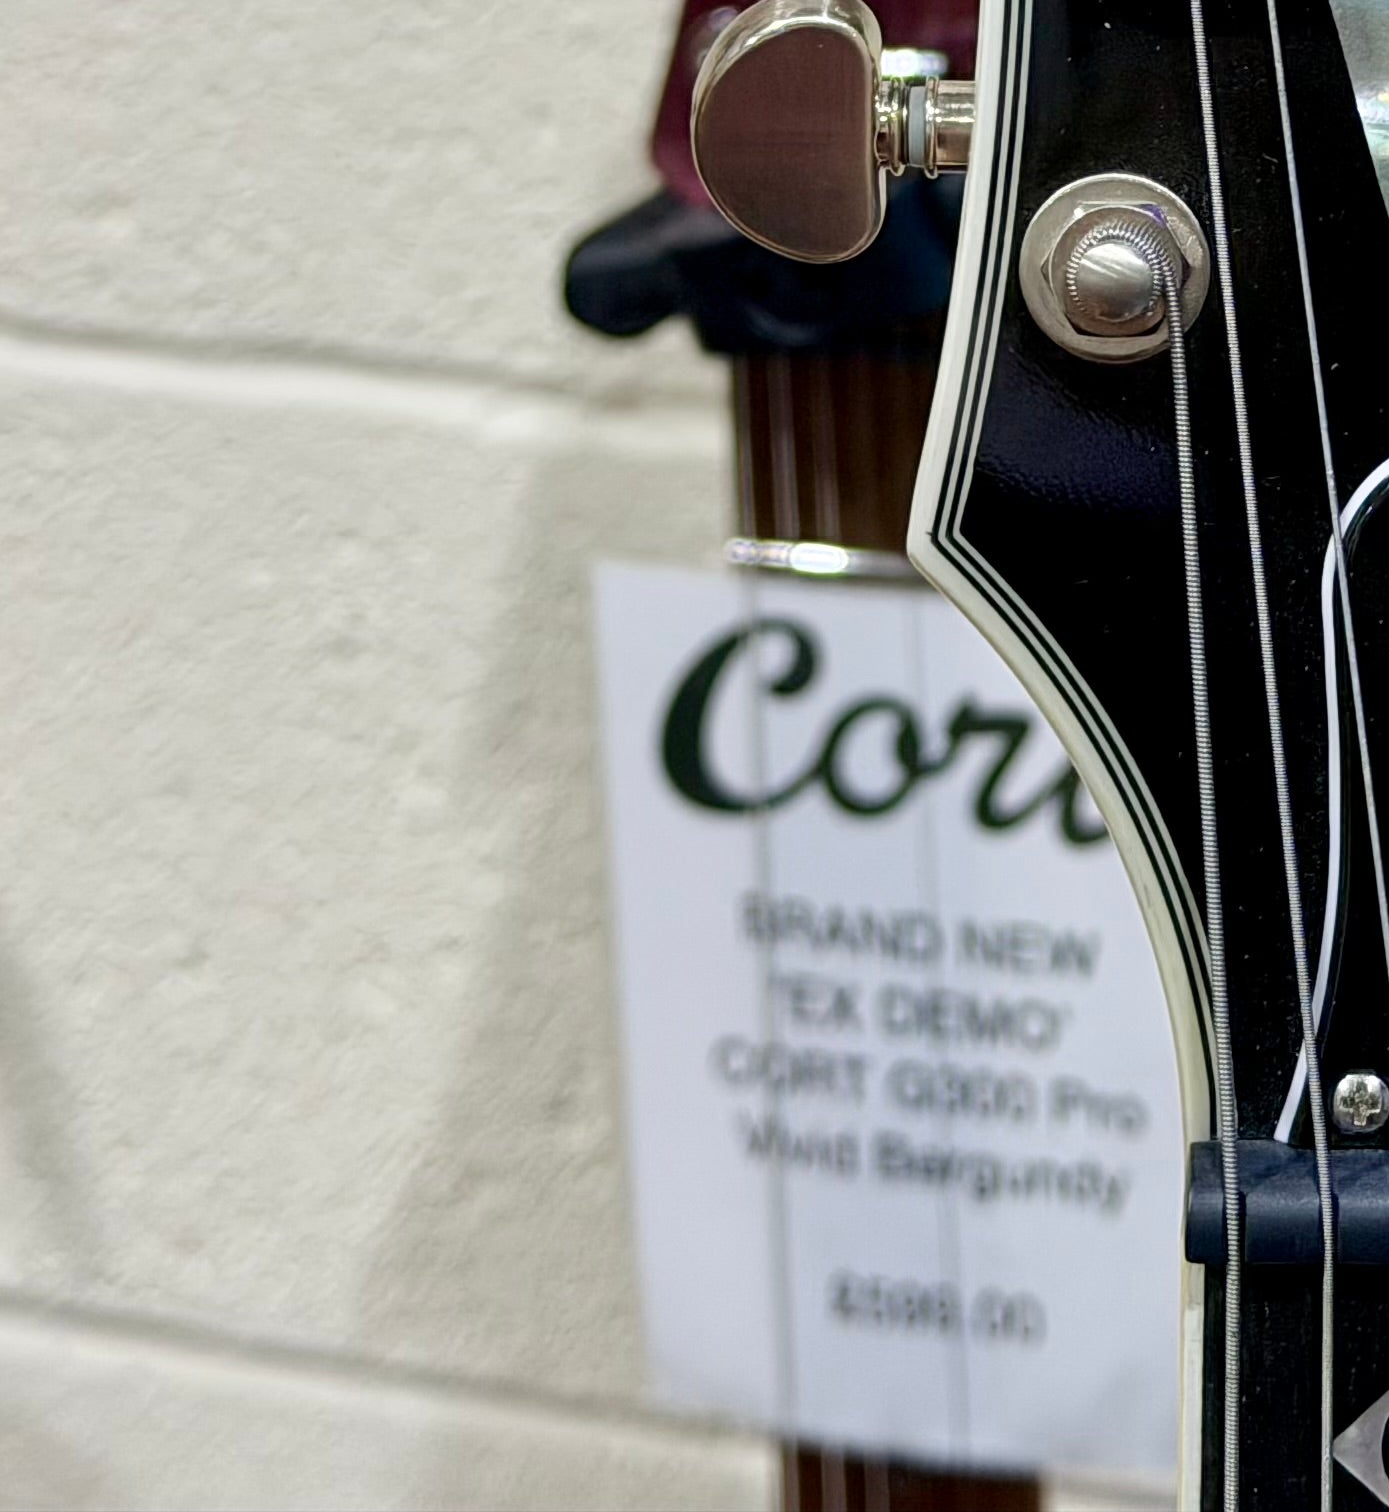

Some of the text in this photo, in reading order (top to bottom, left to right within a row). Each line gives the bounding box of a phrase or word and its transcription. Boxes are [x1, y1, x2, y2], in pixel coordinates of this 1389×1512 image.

[738, 892, 1098, 976] BRAND NEW
[712, 1036, 868, 1102] CORT
[1050, 1076, 1148, 1136] Pro
